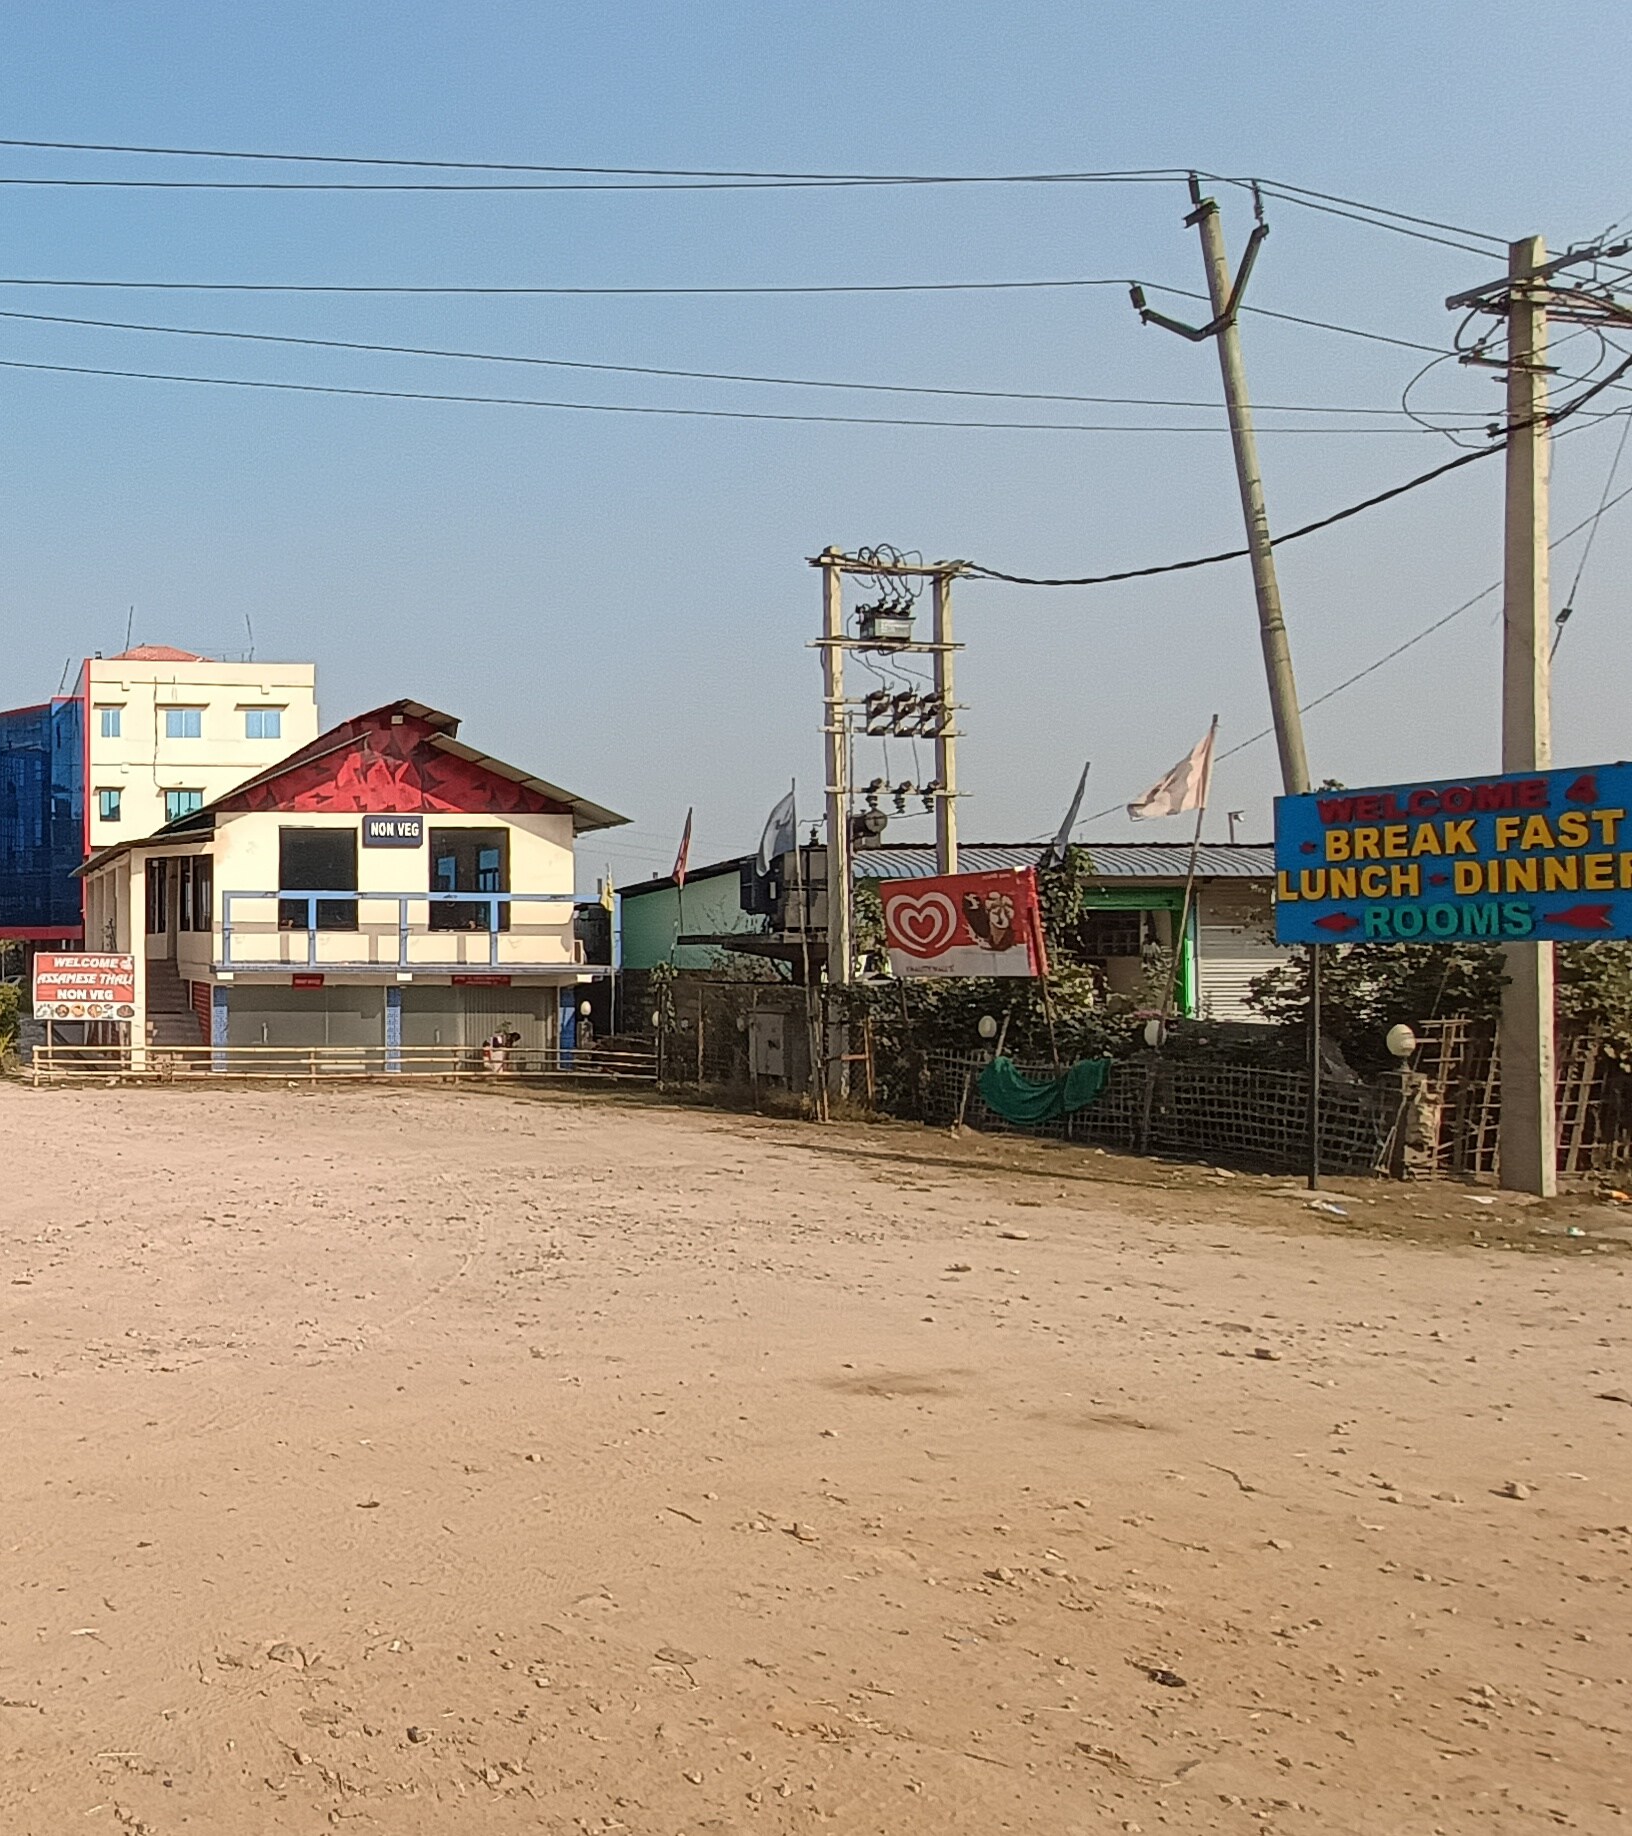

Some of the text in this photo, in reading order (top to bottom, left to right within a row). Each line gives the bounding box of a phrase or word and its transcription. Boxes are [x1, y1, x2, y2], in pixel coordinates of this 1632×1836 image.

[1316, 774, 1598, 825] WELCOME 4
[370, 822, 419, 837] NON VEG
[1324, 808, 1625, 862] BREAK FAST
[1277, 863, 1421, 901] LUNCH
[1364, 901, 1534, 938] ROOMS
[53, 957, 119, 968] WELCOME
[37, 973, 97, 985] ASSAMESE
[57, 989, 114, 1001] NON VEG
